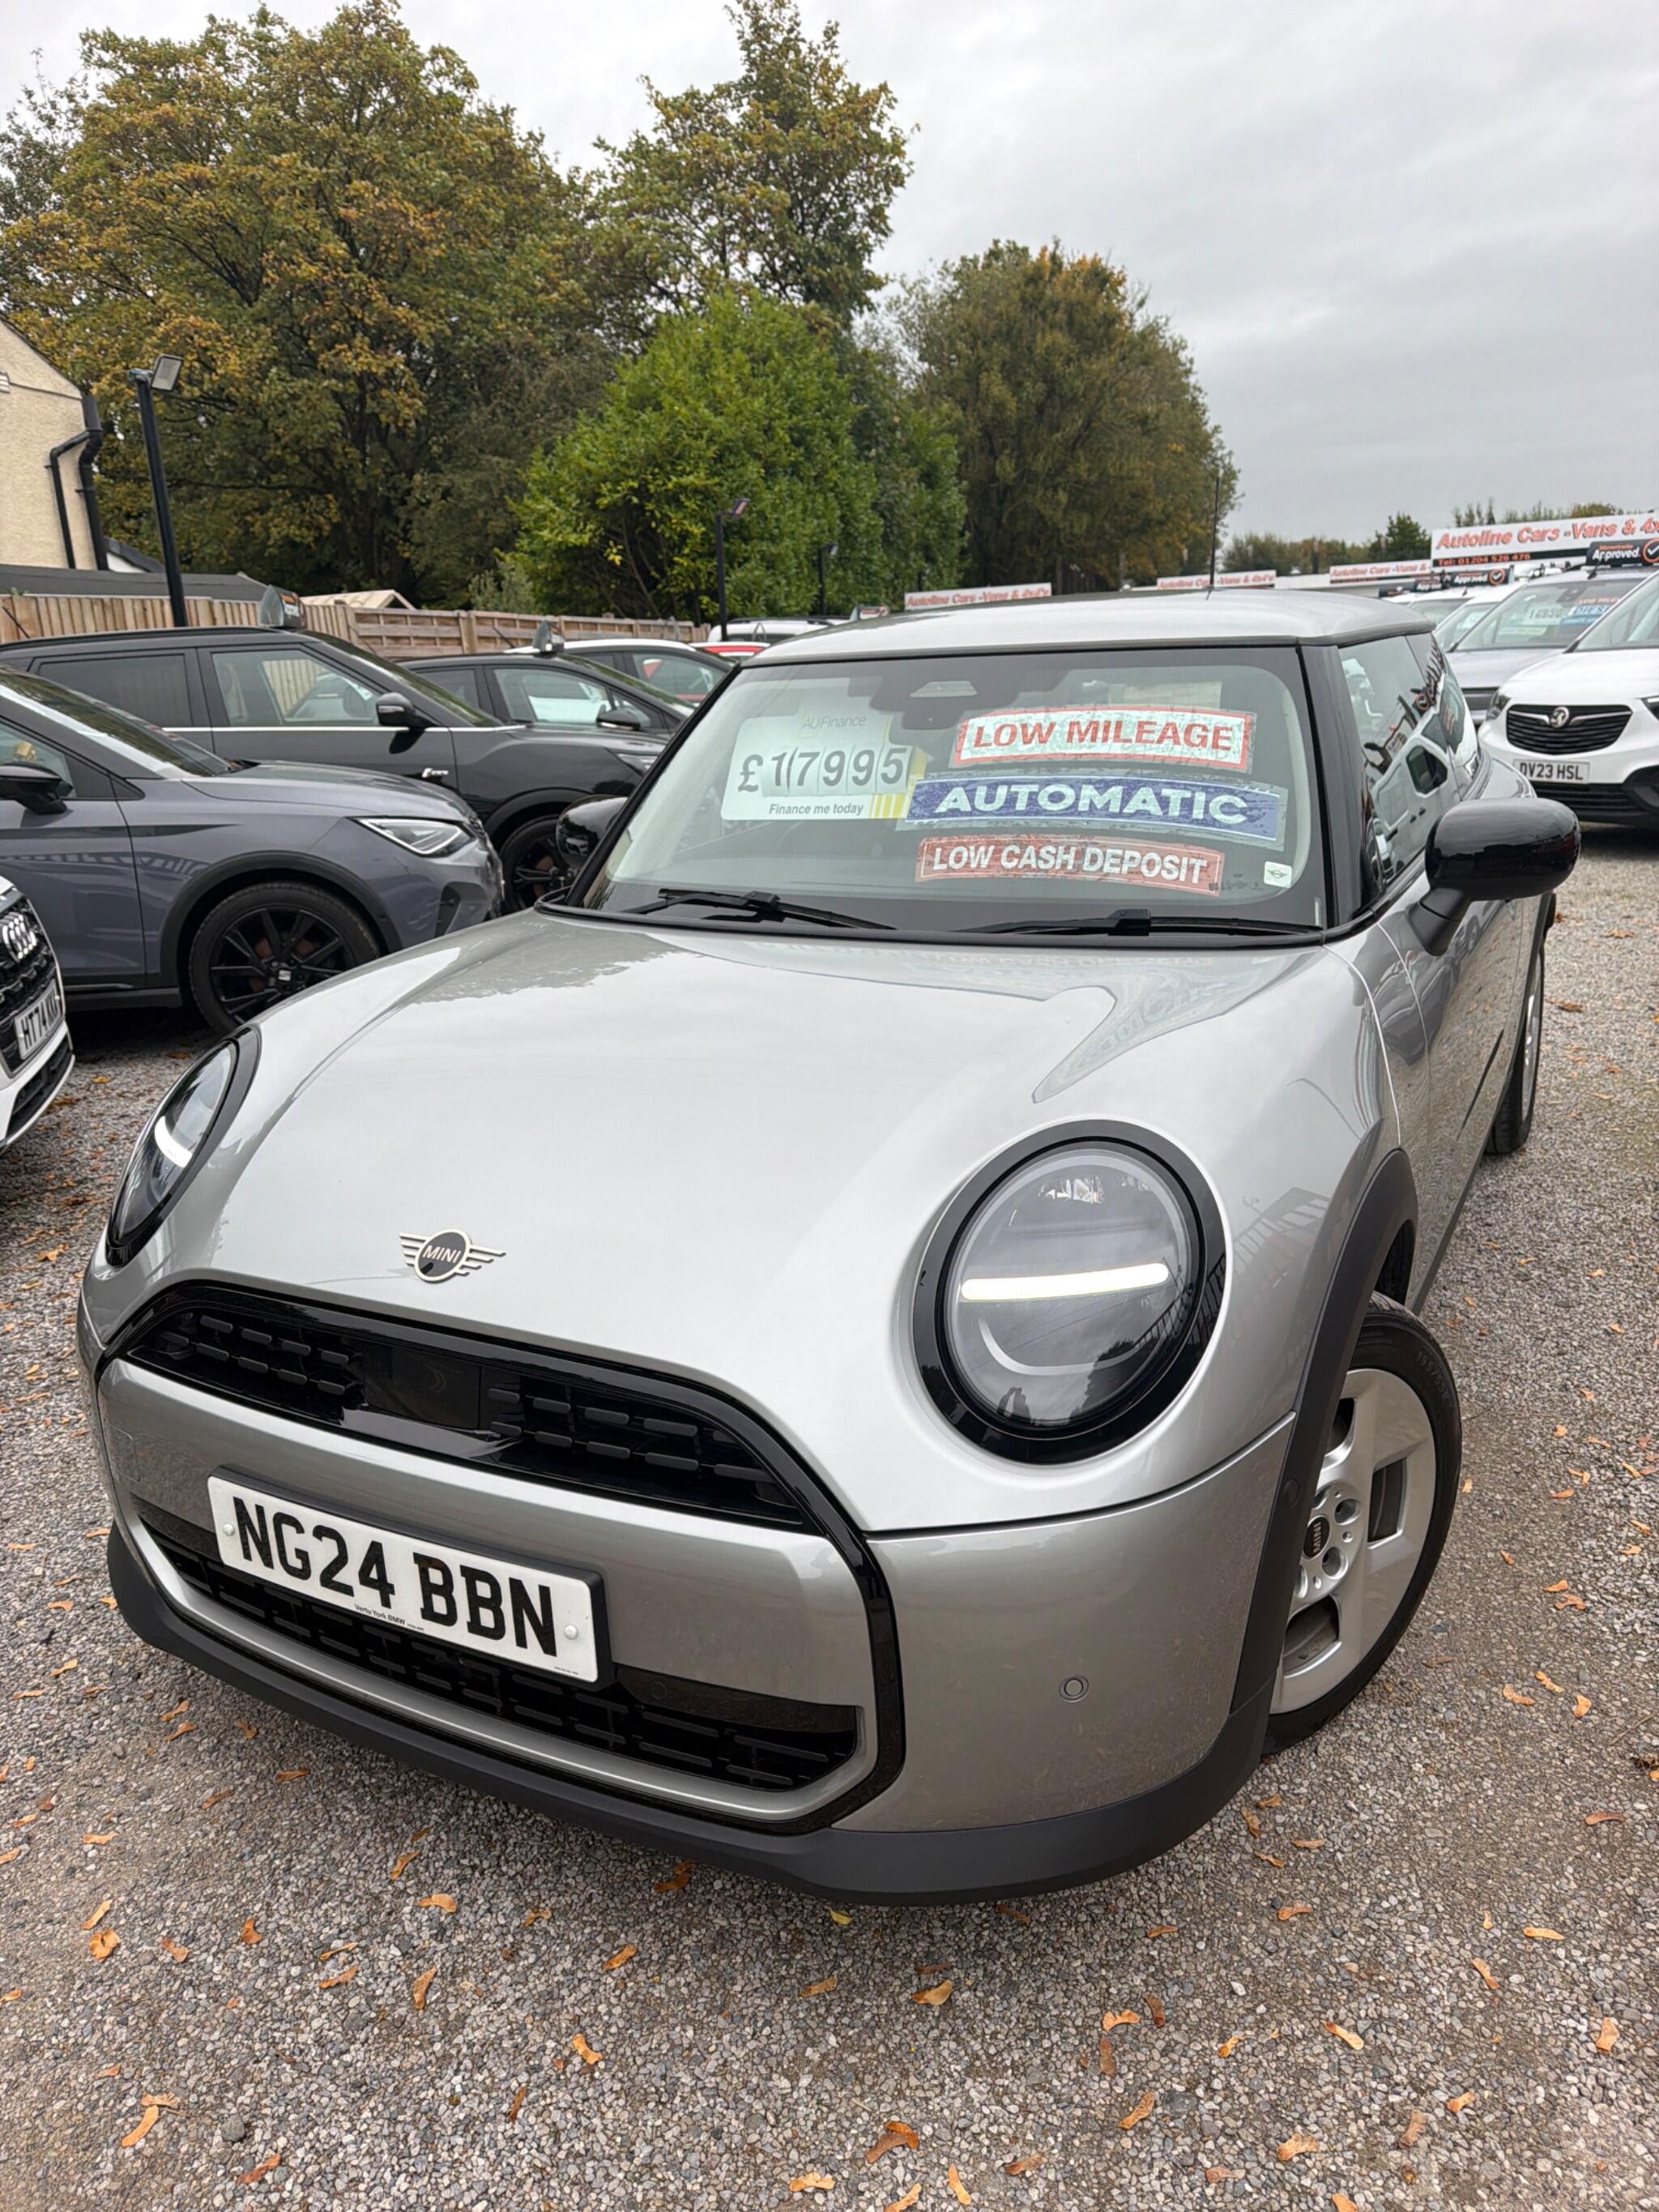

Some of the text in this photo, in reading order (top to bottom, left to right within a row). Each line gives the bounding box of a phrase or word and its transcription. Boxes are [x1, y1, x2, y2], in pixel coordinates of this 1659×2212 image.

[1436, 529, 1512, 549] Autoline
[1517, 527, 1559, 543] Cars
[1622, 519, 1636, 535] &
[973, 720, 1232, 751] LOW MILEAGE
[1519, 762, 1584, 780] DV23 HSL
[770, 803, 864, 816] Finance me today
[934, 784, 1248, 824] AUTOMATIC
[932, 843, 1207, 884] LOW CASH DEPOSIT
[423, 1245, 462, 1264] MINI
[1313, 1521, 1322, 1553] MINI
[232, 1496, 557, 1658] NG24 BBN
[373, 1608, 387, 1620] York
[388, 1614, 406, 1625] BMW
